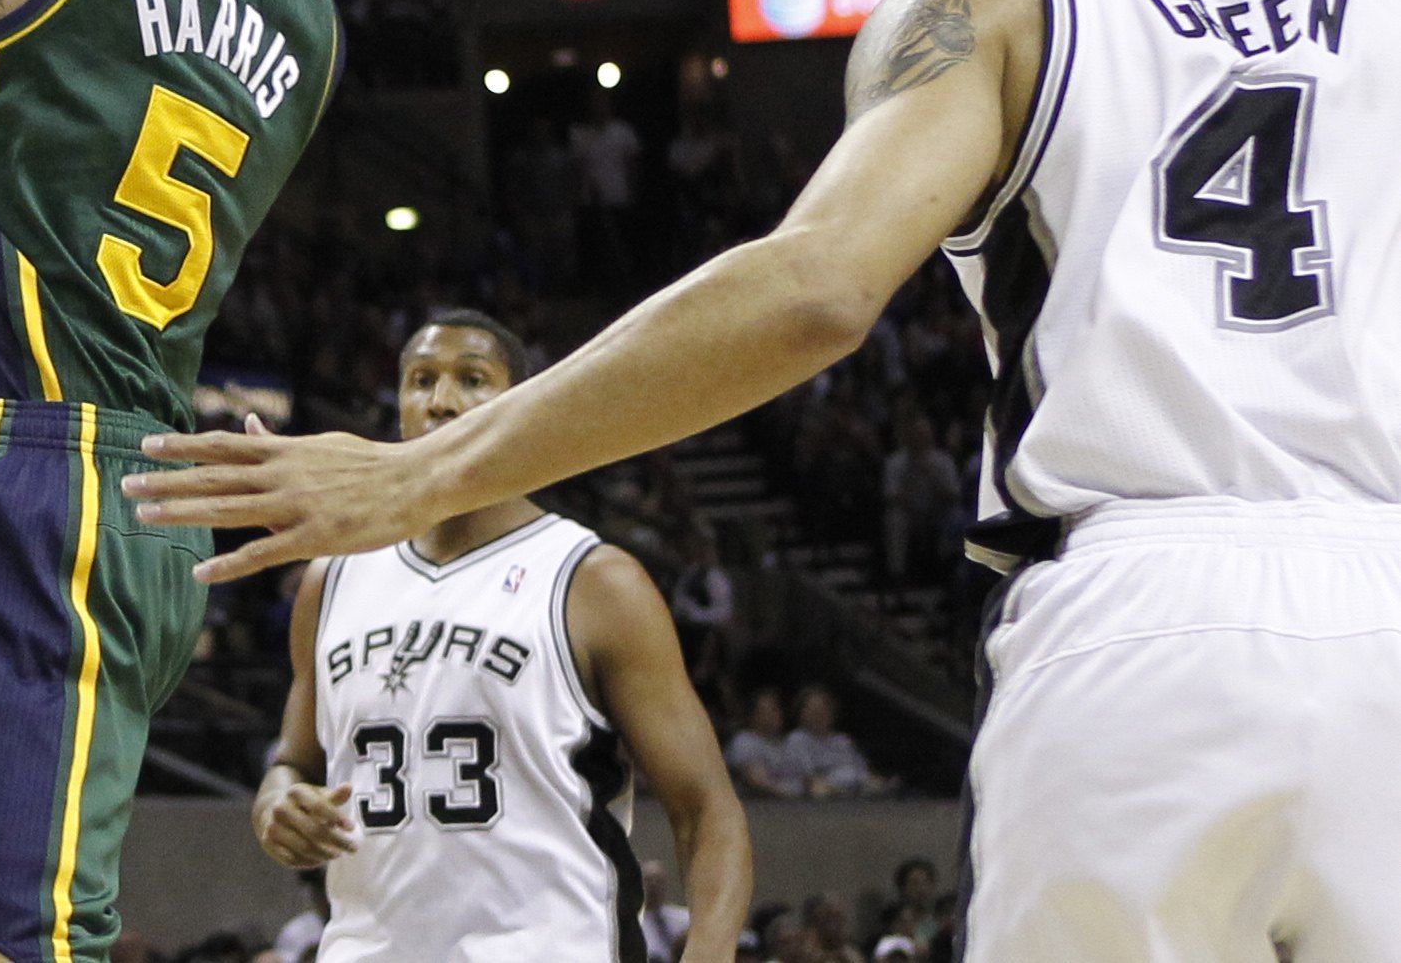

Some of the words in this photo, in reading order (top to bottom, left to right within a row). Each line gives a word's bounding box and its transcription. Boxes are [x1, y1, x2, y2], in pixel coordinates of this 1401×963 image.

[96, 84, 251, 331] 5
[1150, 73, 1337, 334] 4
[326, 619, 531, 689] SPURS
[351, 716, 504, 835] 33
